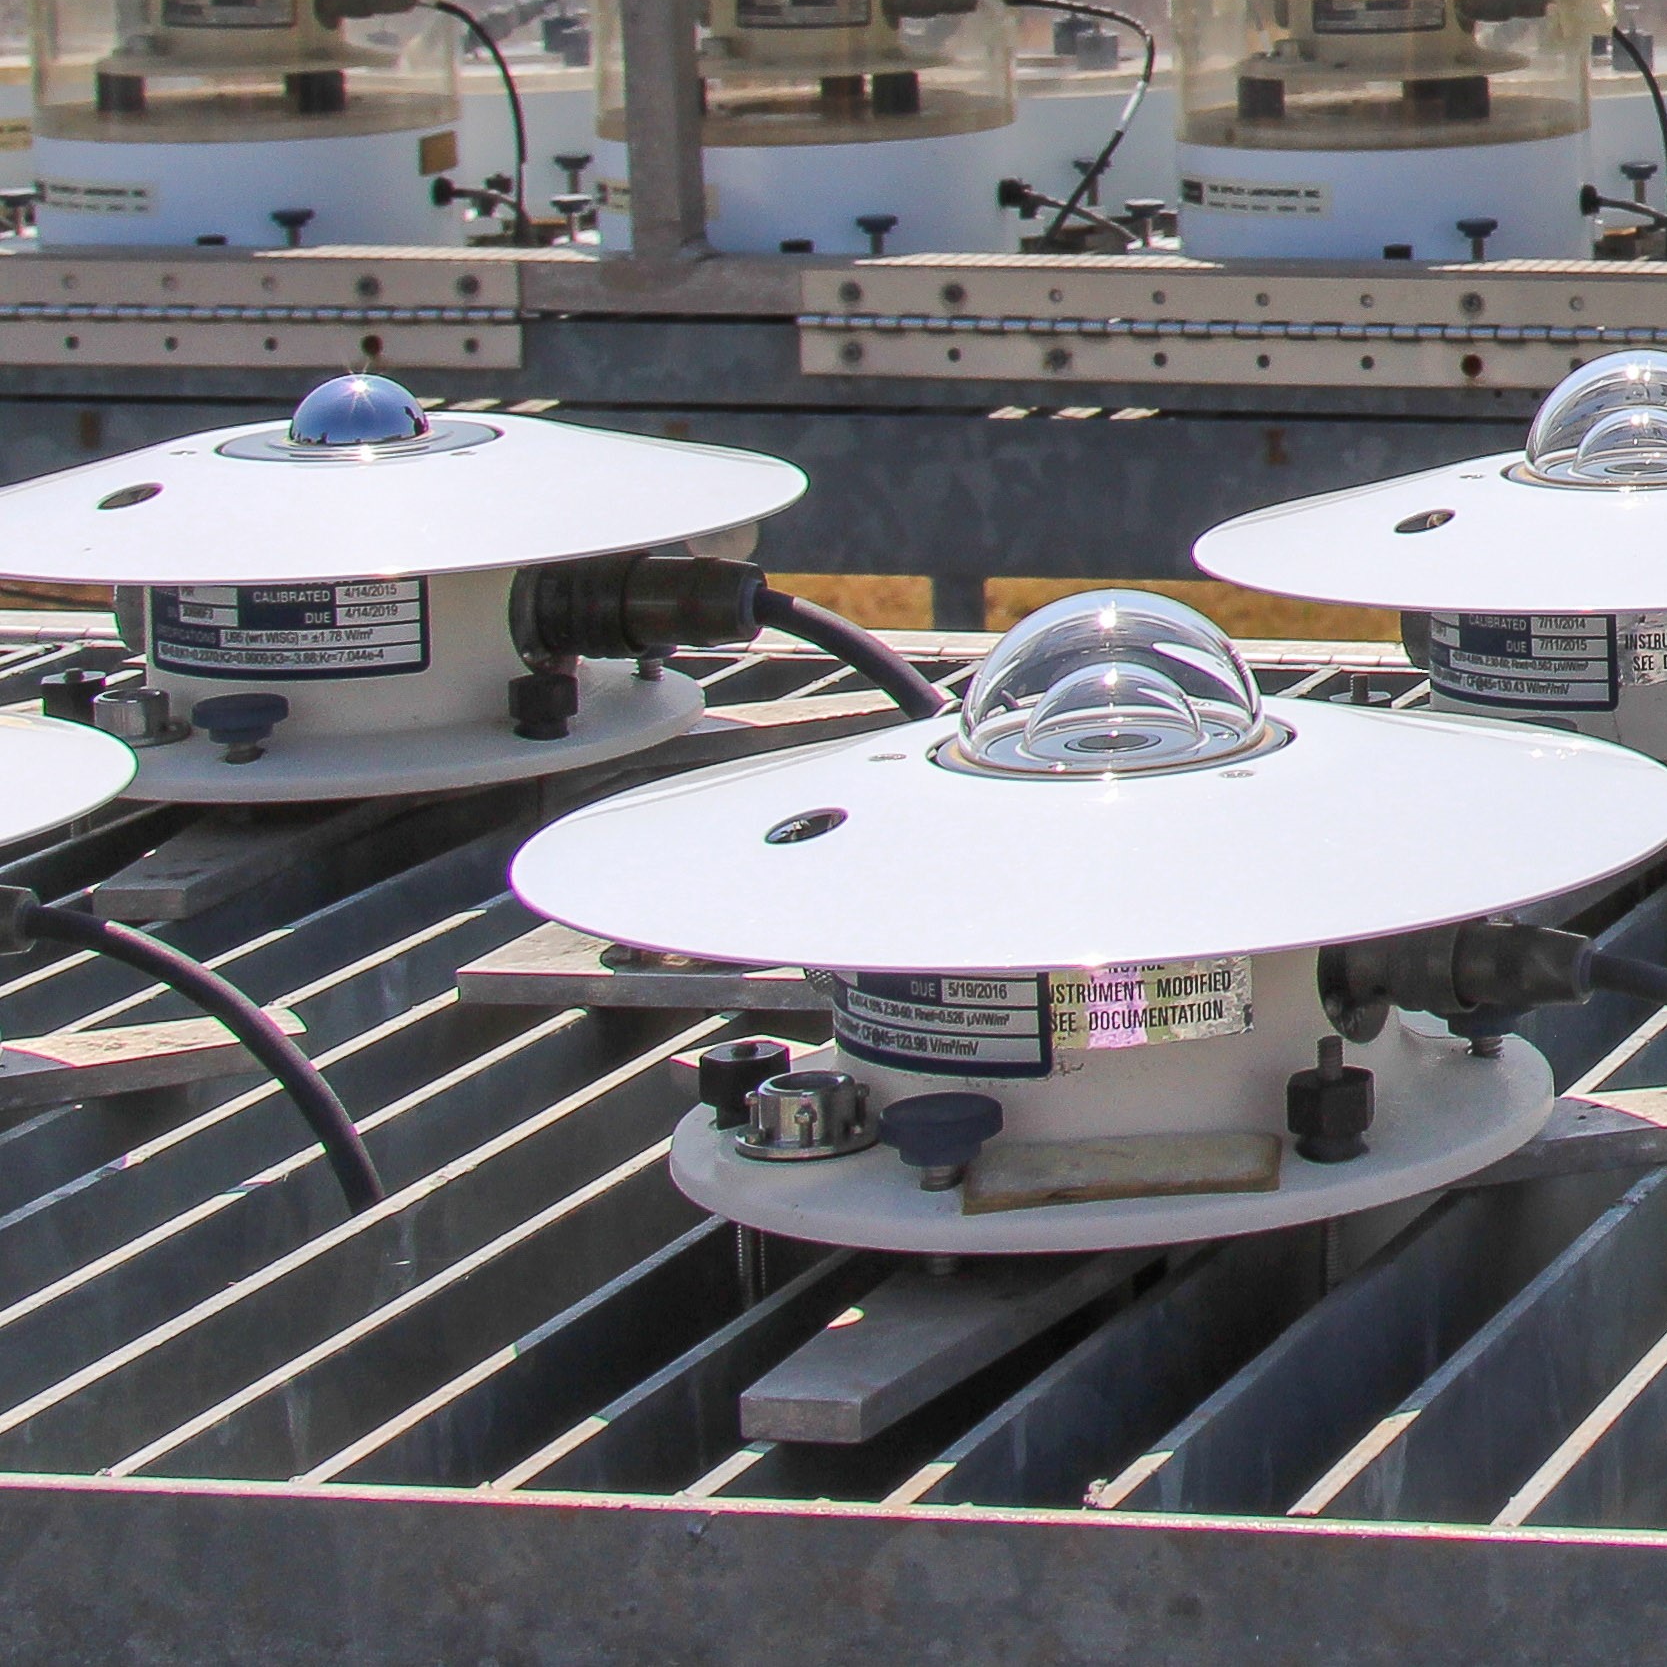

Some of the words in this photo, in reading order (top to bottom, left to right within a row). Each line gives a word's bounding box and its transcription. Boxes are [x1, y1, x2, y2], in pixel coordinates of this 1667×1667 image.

[253, 589, 331, 603] CALIBRATED
[343, 584, 397, 598] 4/14/2015
[305, 611, 332, 624] DUE
[345, 605, 398, 619] 4/14/2019
[1468, 615, 1527, 631] CALIBRATED
[1538, 617, 1586, 630] 7/11/2014
[1506, 639, 1527, 653] DUE
[1539, 638, 1588, 652] 7/11/2015
[1633, 654, 1654, 671] SEE
[910, 980, 936, 997] DUE
[948, 982, 1008, 1000] 5/19/2016
[1050, 980, 1145, 1004] STRUMENT
[1156, 970, 1232, 998] MODIFIED
[1050, 1011, 1076, 1033] SEE
[1088, 999, 1224, 1031] DOCUMENTATION
